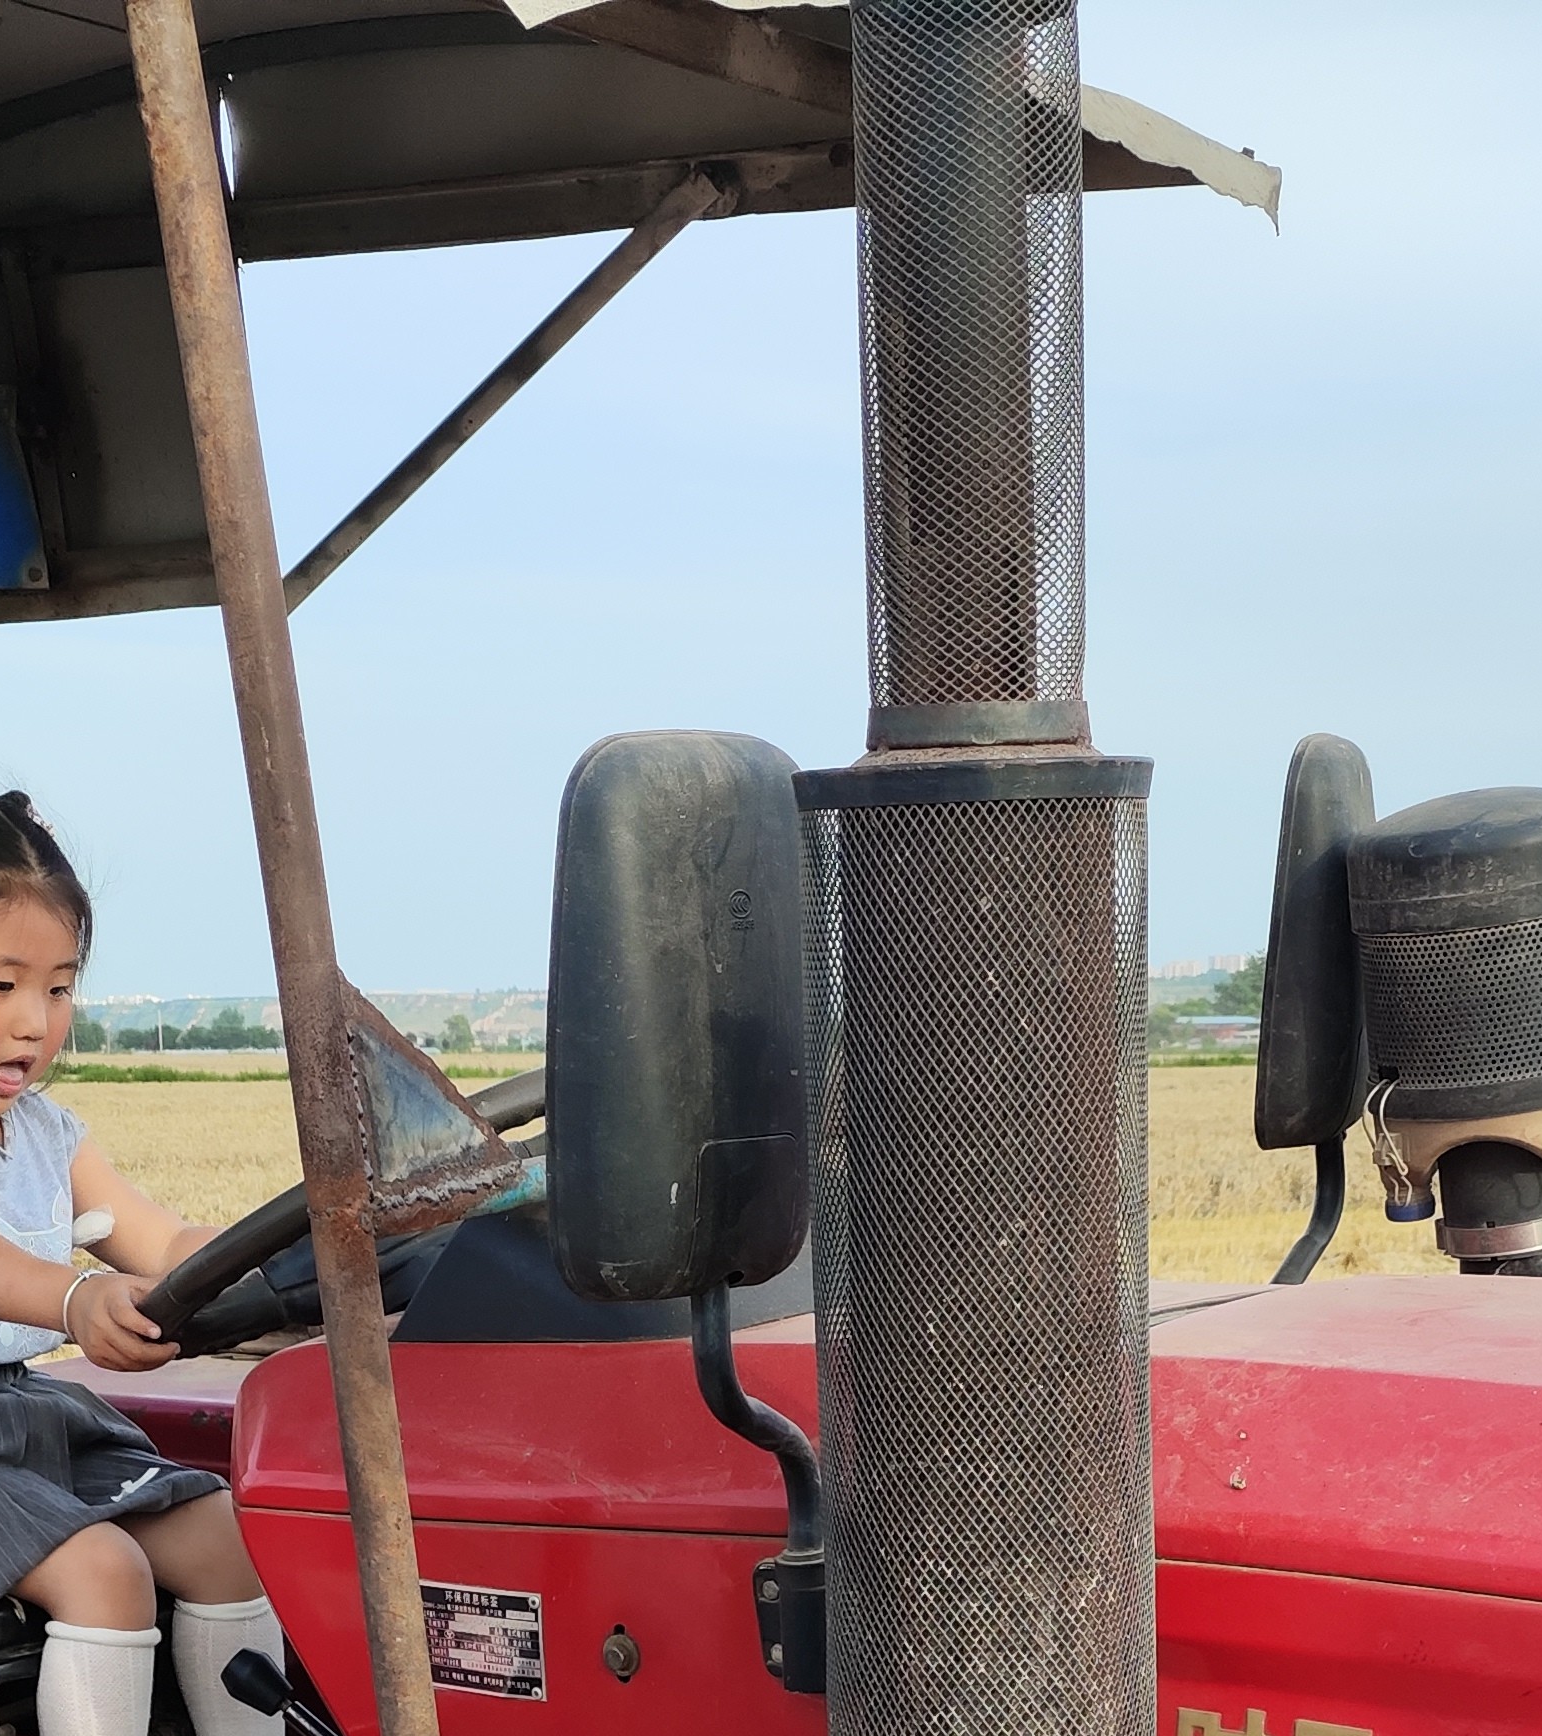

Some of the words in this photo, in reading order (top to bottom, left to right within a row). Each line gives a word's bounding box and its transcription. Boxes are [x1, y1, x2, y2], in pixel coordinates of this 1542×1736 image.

[444, 1589, 499, 1608] 环保信息标签
